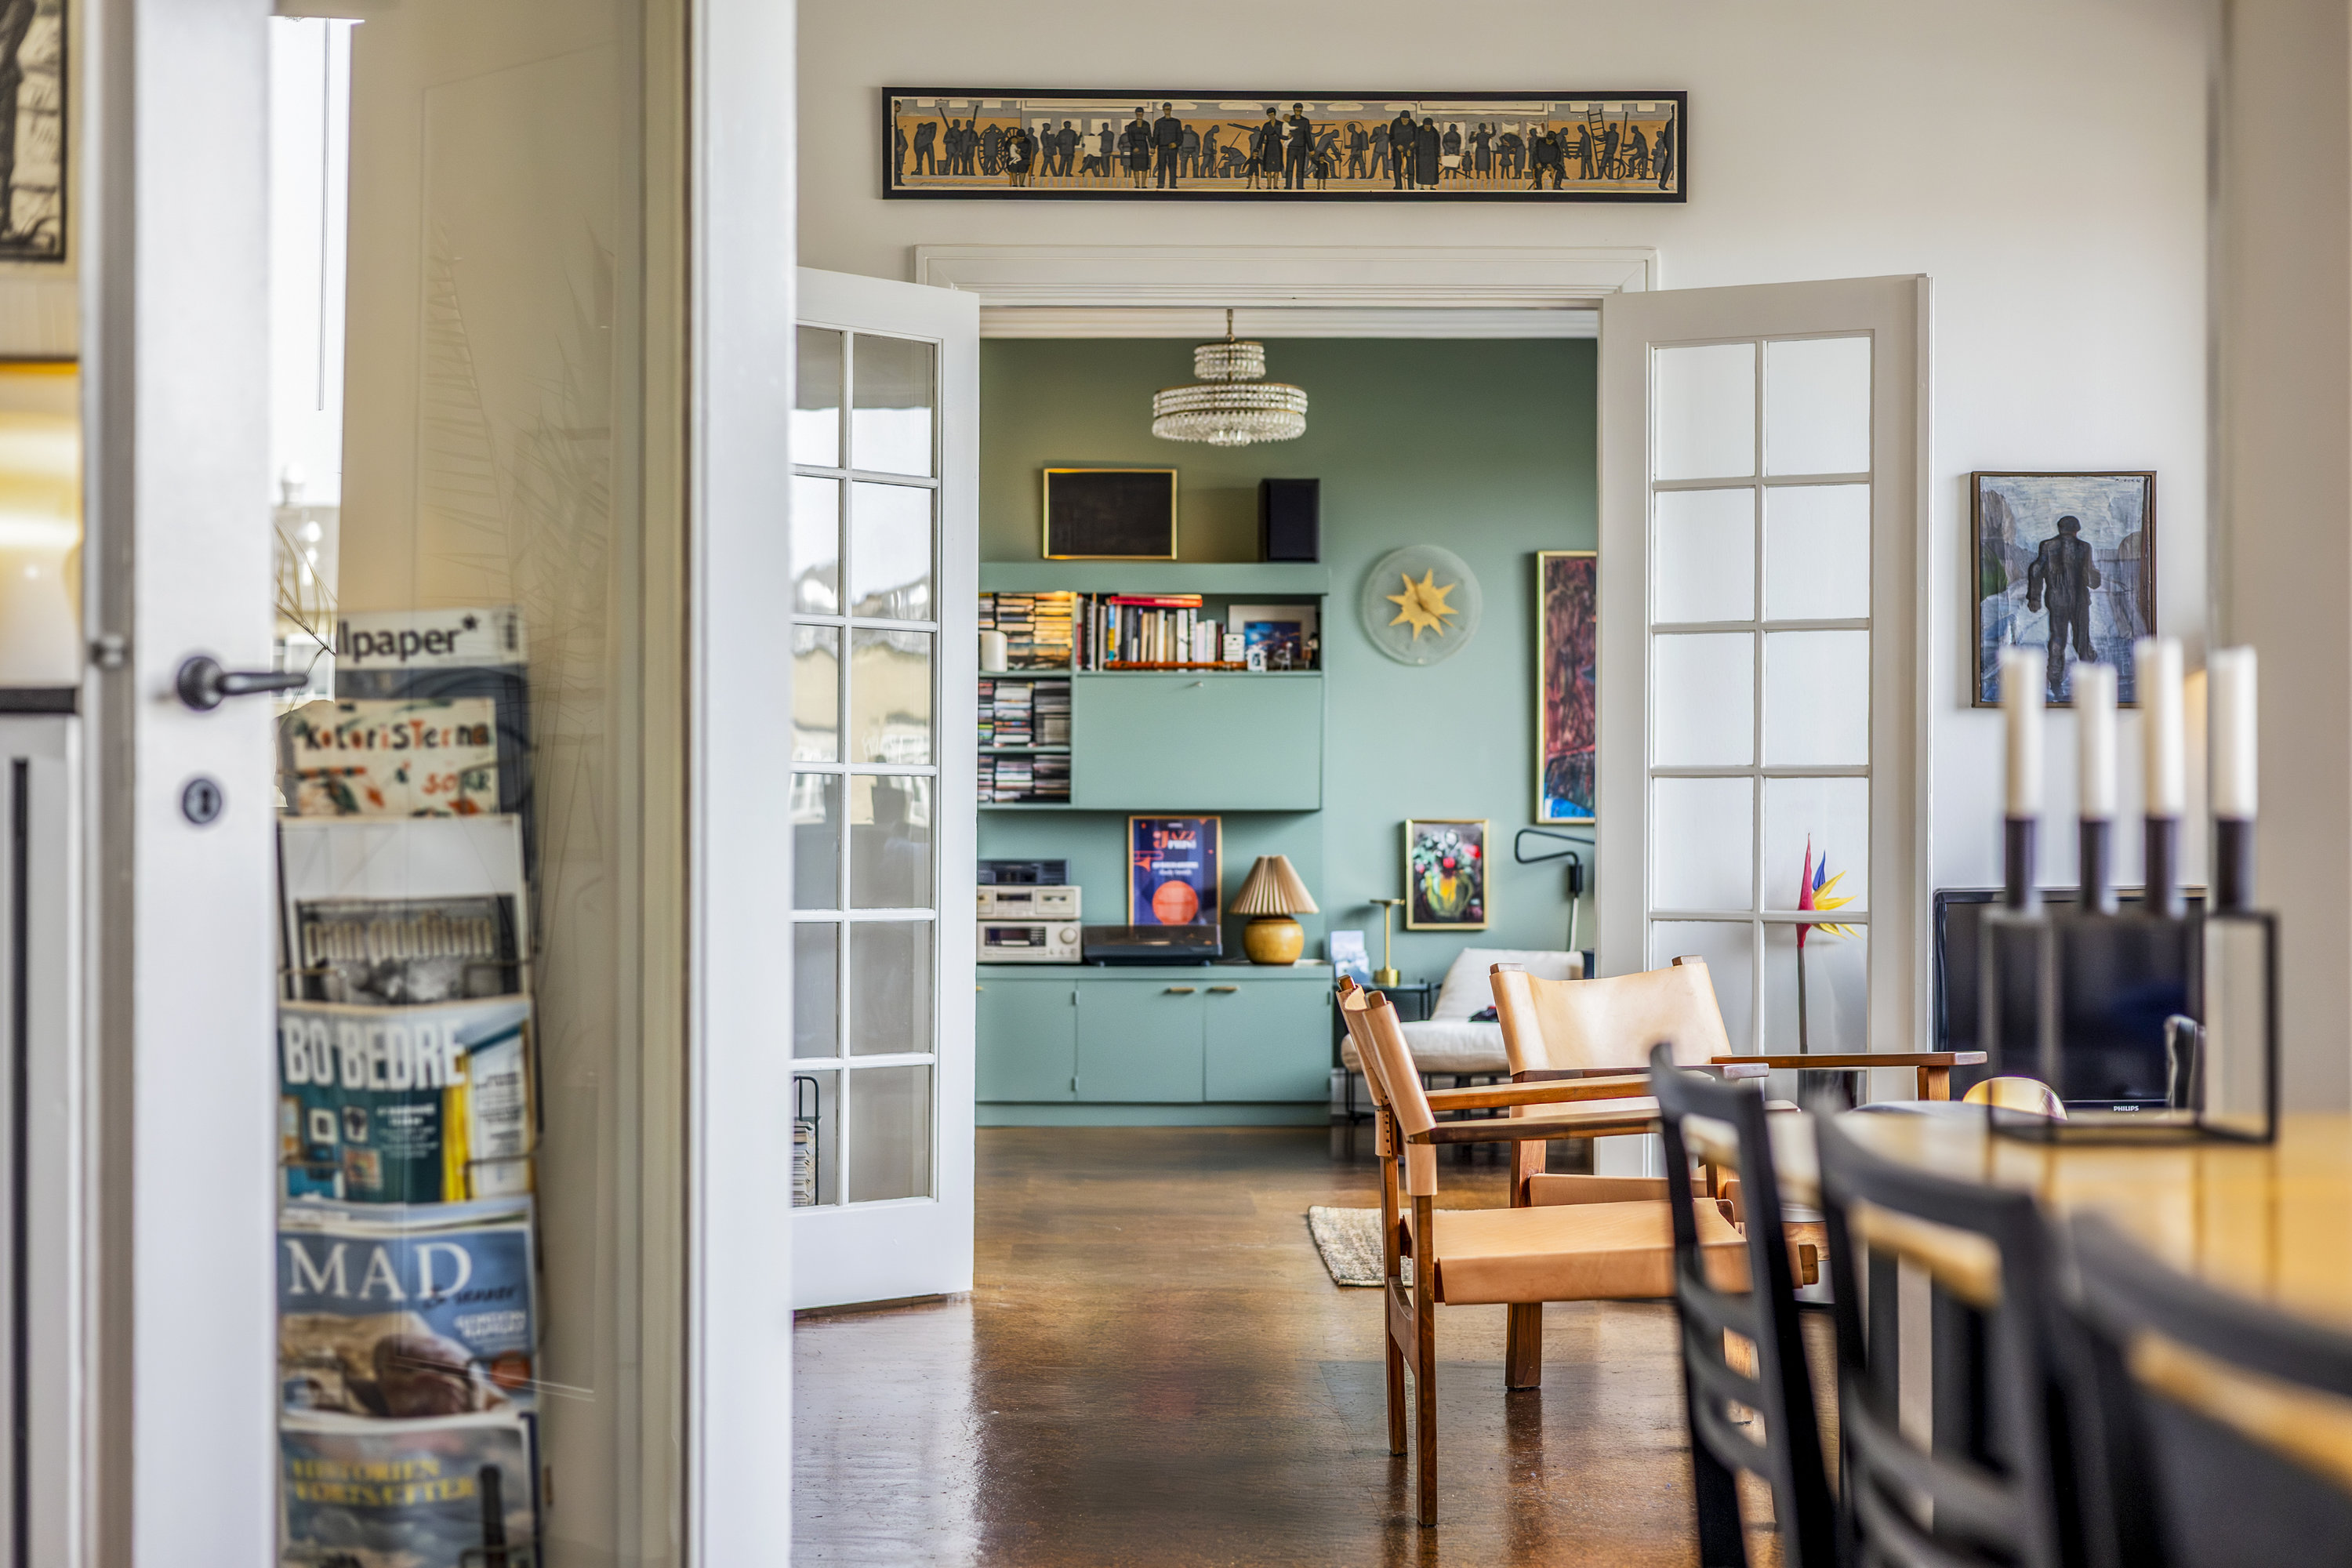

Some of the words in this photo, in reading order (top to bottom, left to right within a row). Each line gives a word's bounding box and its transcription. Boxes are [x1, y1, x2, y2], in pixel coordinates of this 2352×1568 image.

[284, 1017, 334, 1087] BO
[339, 1019, 466, 1091] BEDRE
[285, 1239, 471, 1301] MAD
